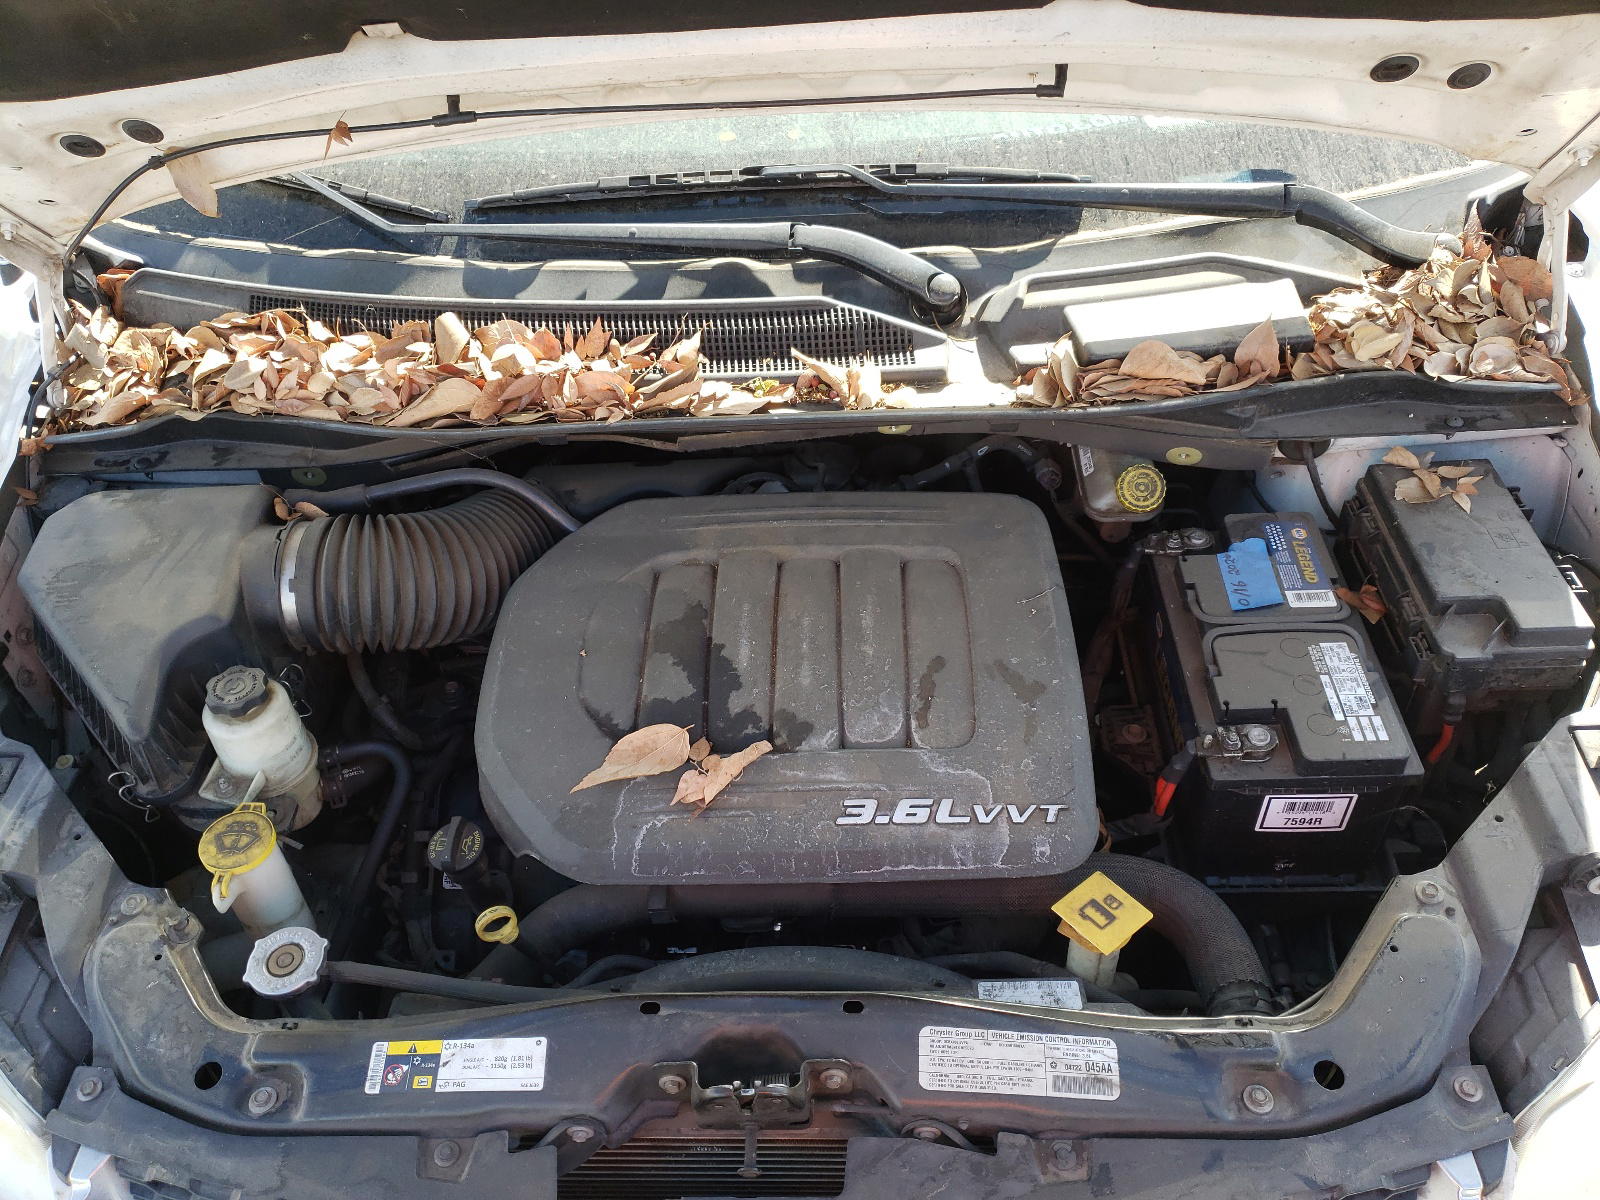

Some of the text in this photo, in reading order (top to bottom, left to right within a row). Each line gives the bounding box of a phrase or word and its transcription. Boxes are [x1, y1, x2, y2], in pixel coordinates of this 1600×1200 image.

[1292, 541, 1319, 584] LEGEND
[835, 798, 1069, 825] 3.6L VVT
[1283, 817, 1323, 826] 7594R
[929, 1028, 953, 1037] Chrysler
[955, 1030, 973, 1039] Group
[974, 1031, 986, 1039] LLC
[1015, 1034, 1043, 1042] EMISSION
[1044, 1036, 1071, 1044] CONTROL
[1072, 1038, 1112, 1047] INFORMATION
[1064, 1061, 1113, 1074] 04722 045AA
